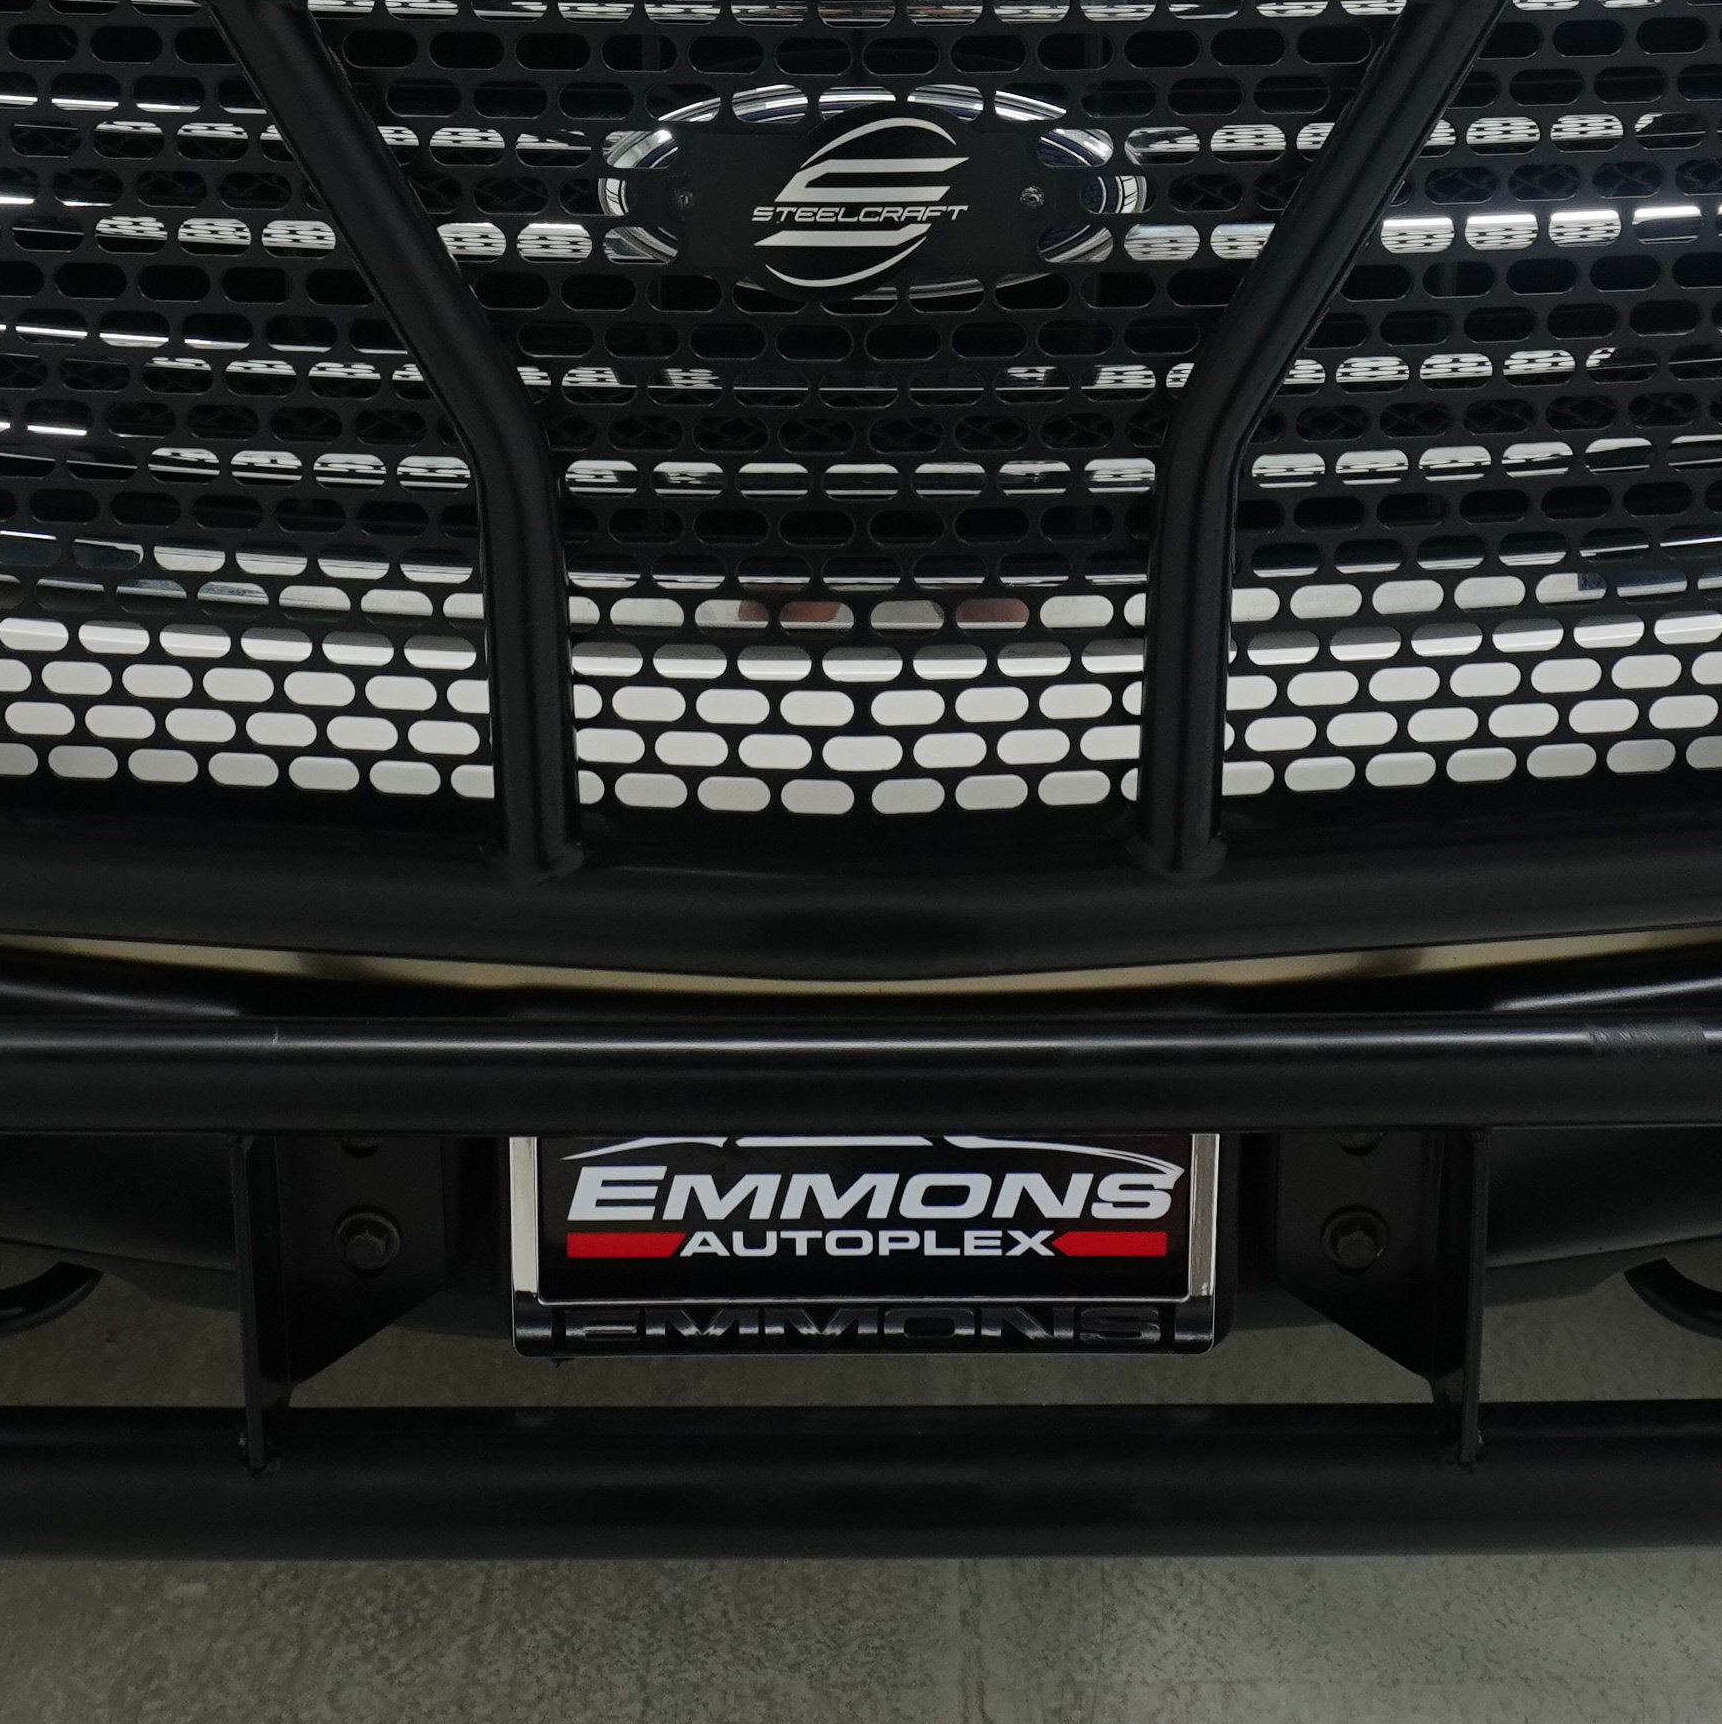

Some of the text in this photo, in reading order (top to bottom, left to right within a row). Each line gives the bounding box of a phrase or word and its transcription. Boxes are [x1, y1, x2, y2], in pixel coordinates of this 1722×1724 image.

[751, 205, 969, 223] STEELCRAFT
[567, 1165, 1176, 1221] EMMONS
[679, 1230, 1056, 1257] AUTOPLEX
[562, 1305, 1163, 1346] EMMONS
